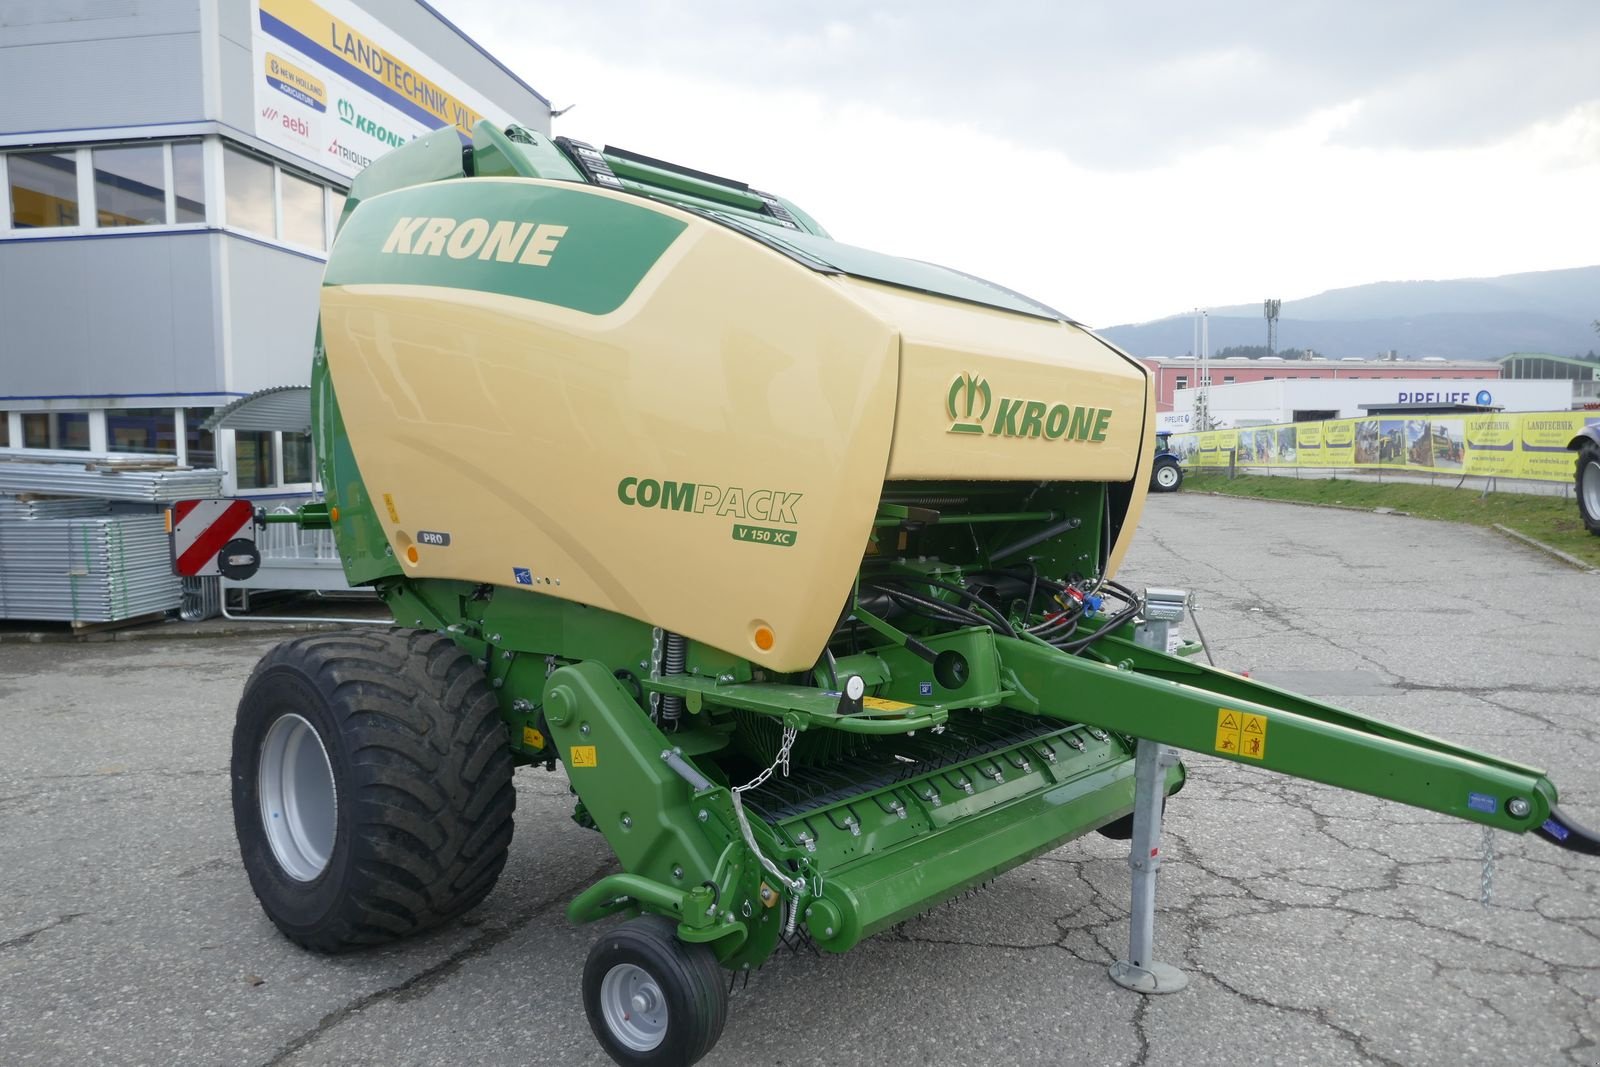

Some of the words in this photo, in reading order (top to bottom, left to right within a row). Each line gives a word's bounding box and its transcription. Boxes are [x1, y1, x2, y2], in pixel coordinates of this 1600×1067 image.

[280, 67, 295, 80] NEW
[296, 75, 323, 97] HOLLAND
[331, 22, 449, 118] LANDTECHNIK
[280, 83, 314, 106] AGRICULTURE
[282, 114, 309, 137] aebi
[381, 216, 569, 267] KRONE
[989, 397, 1112, 443] KRONE
[617, 476, 803, 525] COMPACK
[423, 532, 443, 544] PRO
[739, 528, 748, 538] V
[751, 529, 771, 541] 150
[773, 532, 791, 544] XC
